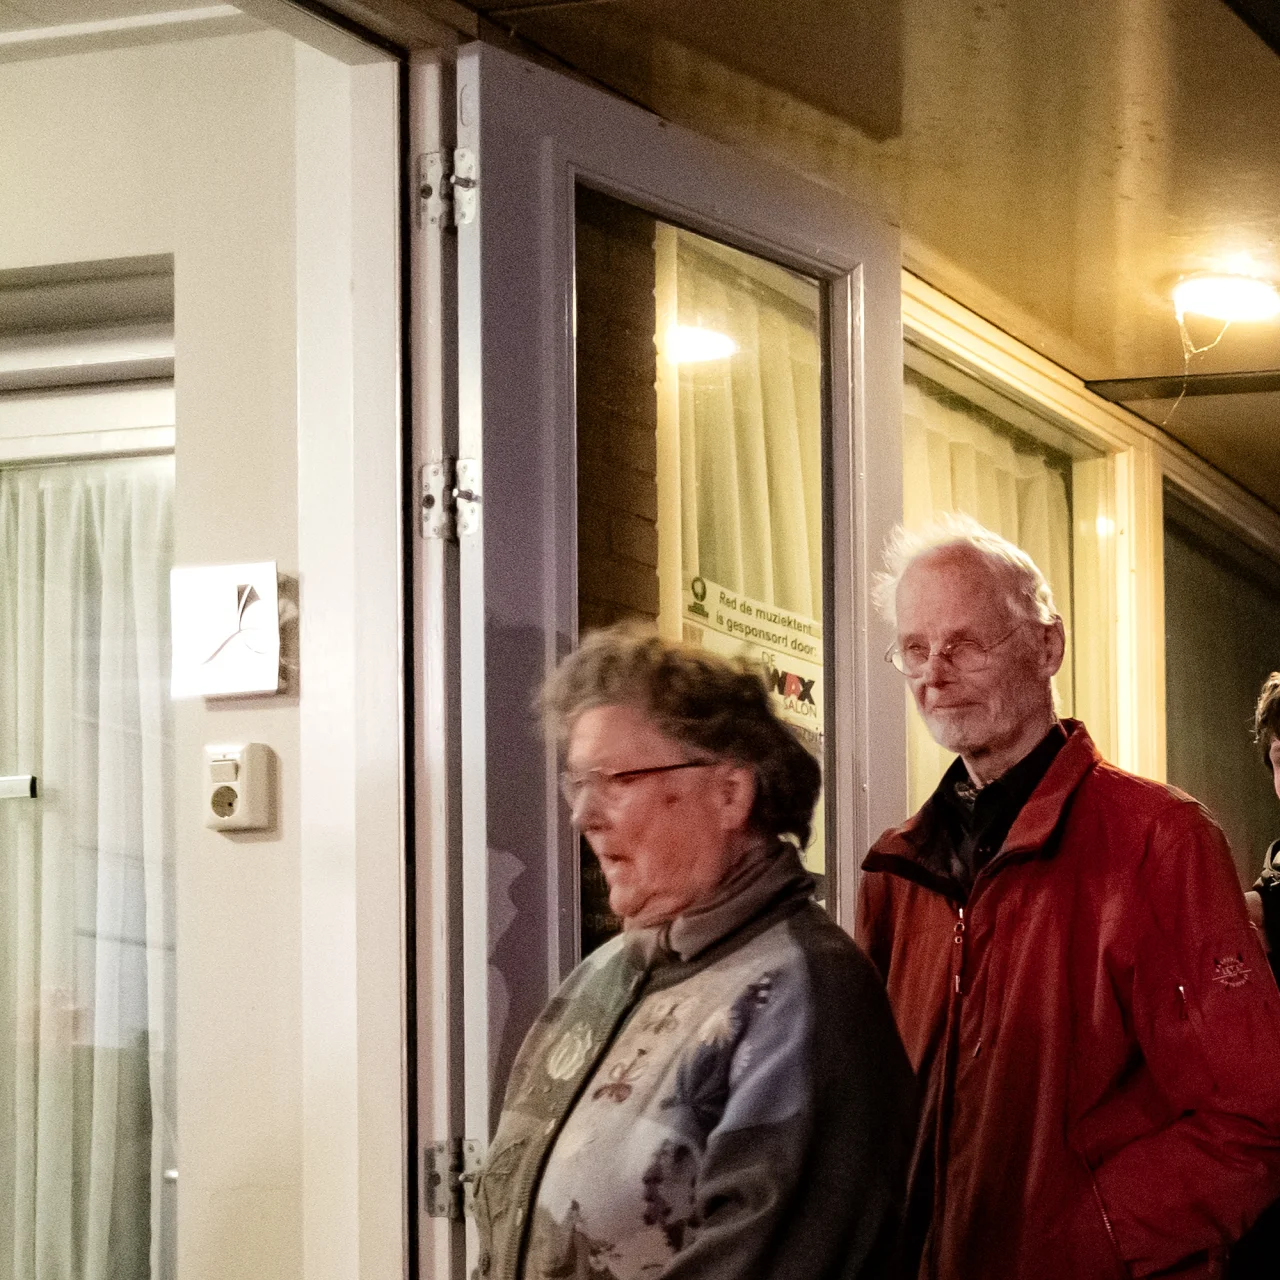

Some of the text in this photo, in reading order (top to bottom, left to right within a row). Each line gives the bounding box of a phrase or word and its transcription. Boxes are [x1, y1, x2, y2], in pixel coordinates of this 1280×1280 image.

[719, 591, 736, 610] Red
[740, 601, 752, 615] de
[716, 610, 724, 625] is
[784, 697, 817, 718] SALON
